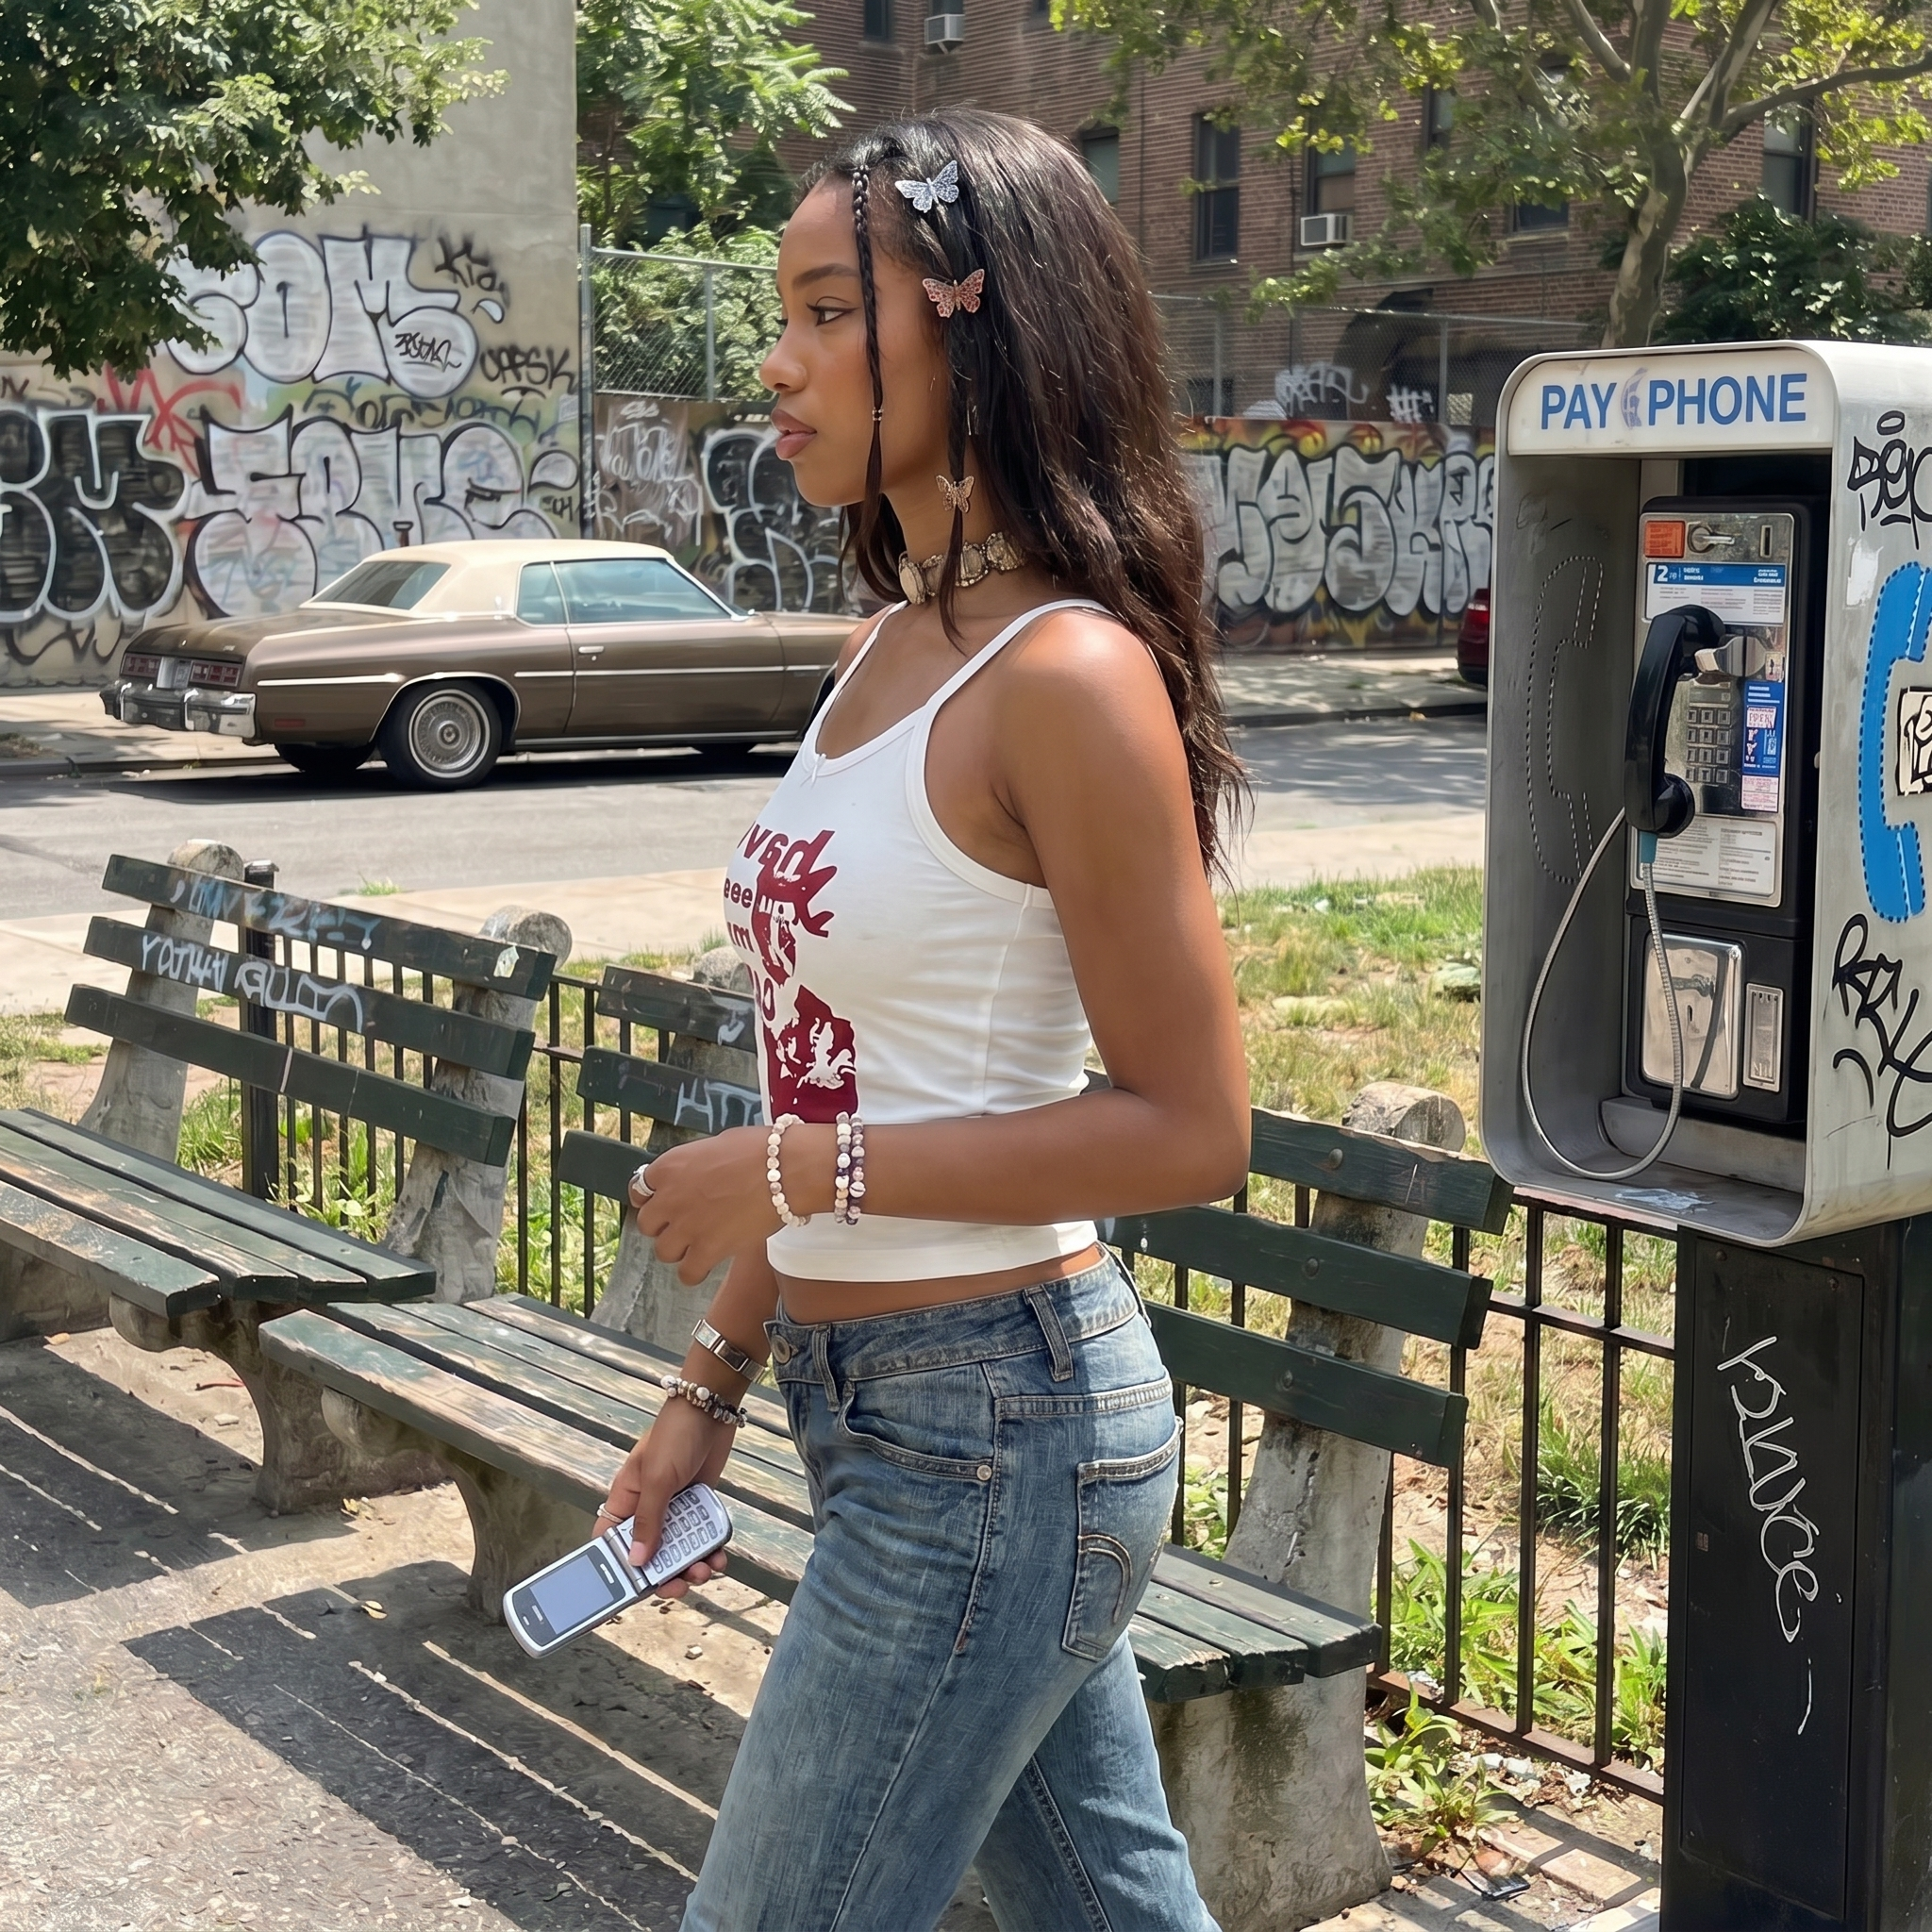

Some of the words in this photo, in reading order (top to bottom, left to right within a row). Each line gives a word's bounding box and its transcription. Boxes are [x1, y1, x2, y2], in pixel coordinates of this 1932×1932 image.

[1541, 382, 1617, 430] PAY
[1648, 373, 1807, 426] PHONE
[1657, 564, 1669, 582] 2
